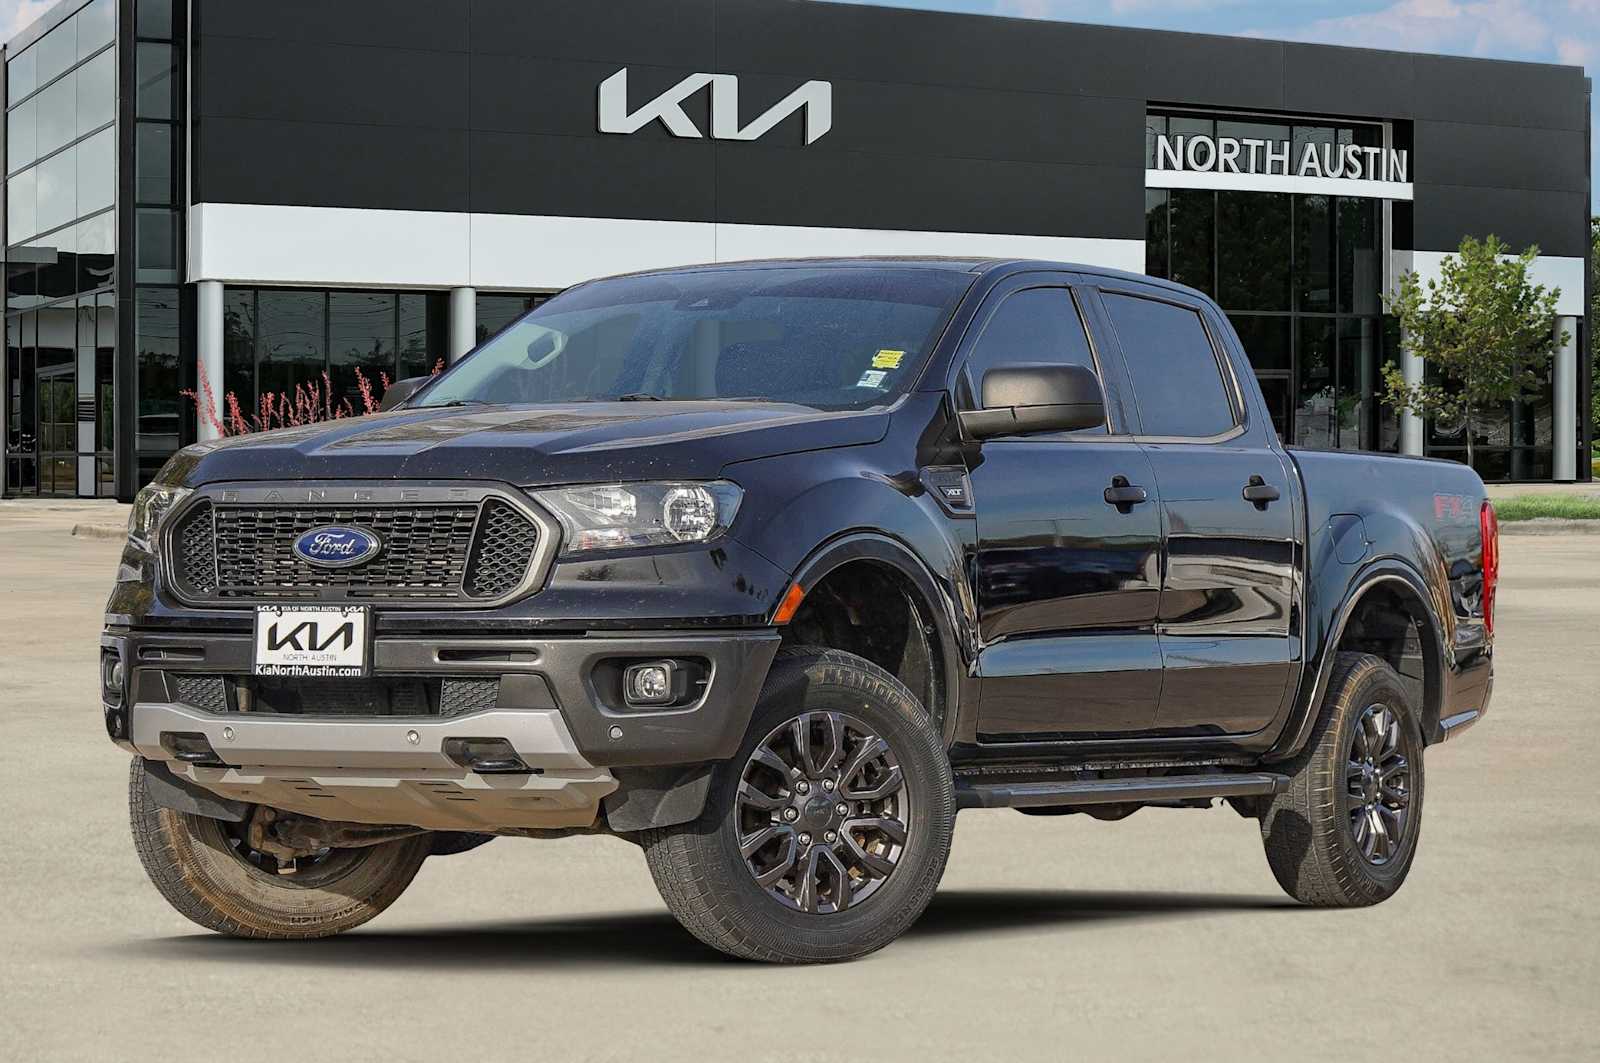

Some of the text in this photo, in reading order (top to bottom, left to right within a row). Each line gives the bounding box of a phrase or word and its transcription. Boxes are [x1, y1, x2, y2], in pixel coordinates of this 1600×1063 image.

[599, 67, 832, 145] KIA
[1157, 134, 1408, 183] NORTH AUSTIN
[221, 489, 469, 501] RANGER
[309, 533, 355, 555] Ford
[268, 622, 353, 651] KIA
[283, 653, 337, 662] NORTH AUSTIN
[256, 664, 361, 677] KiaNorthAustin.com
